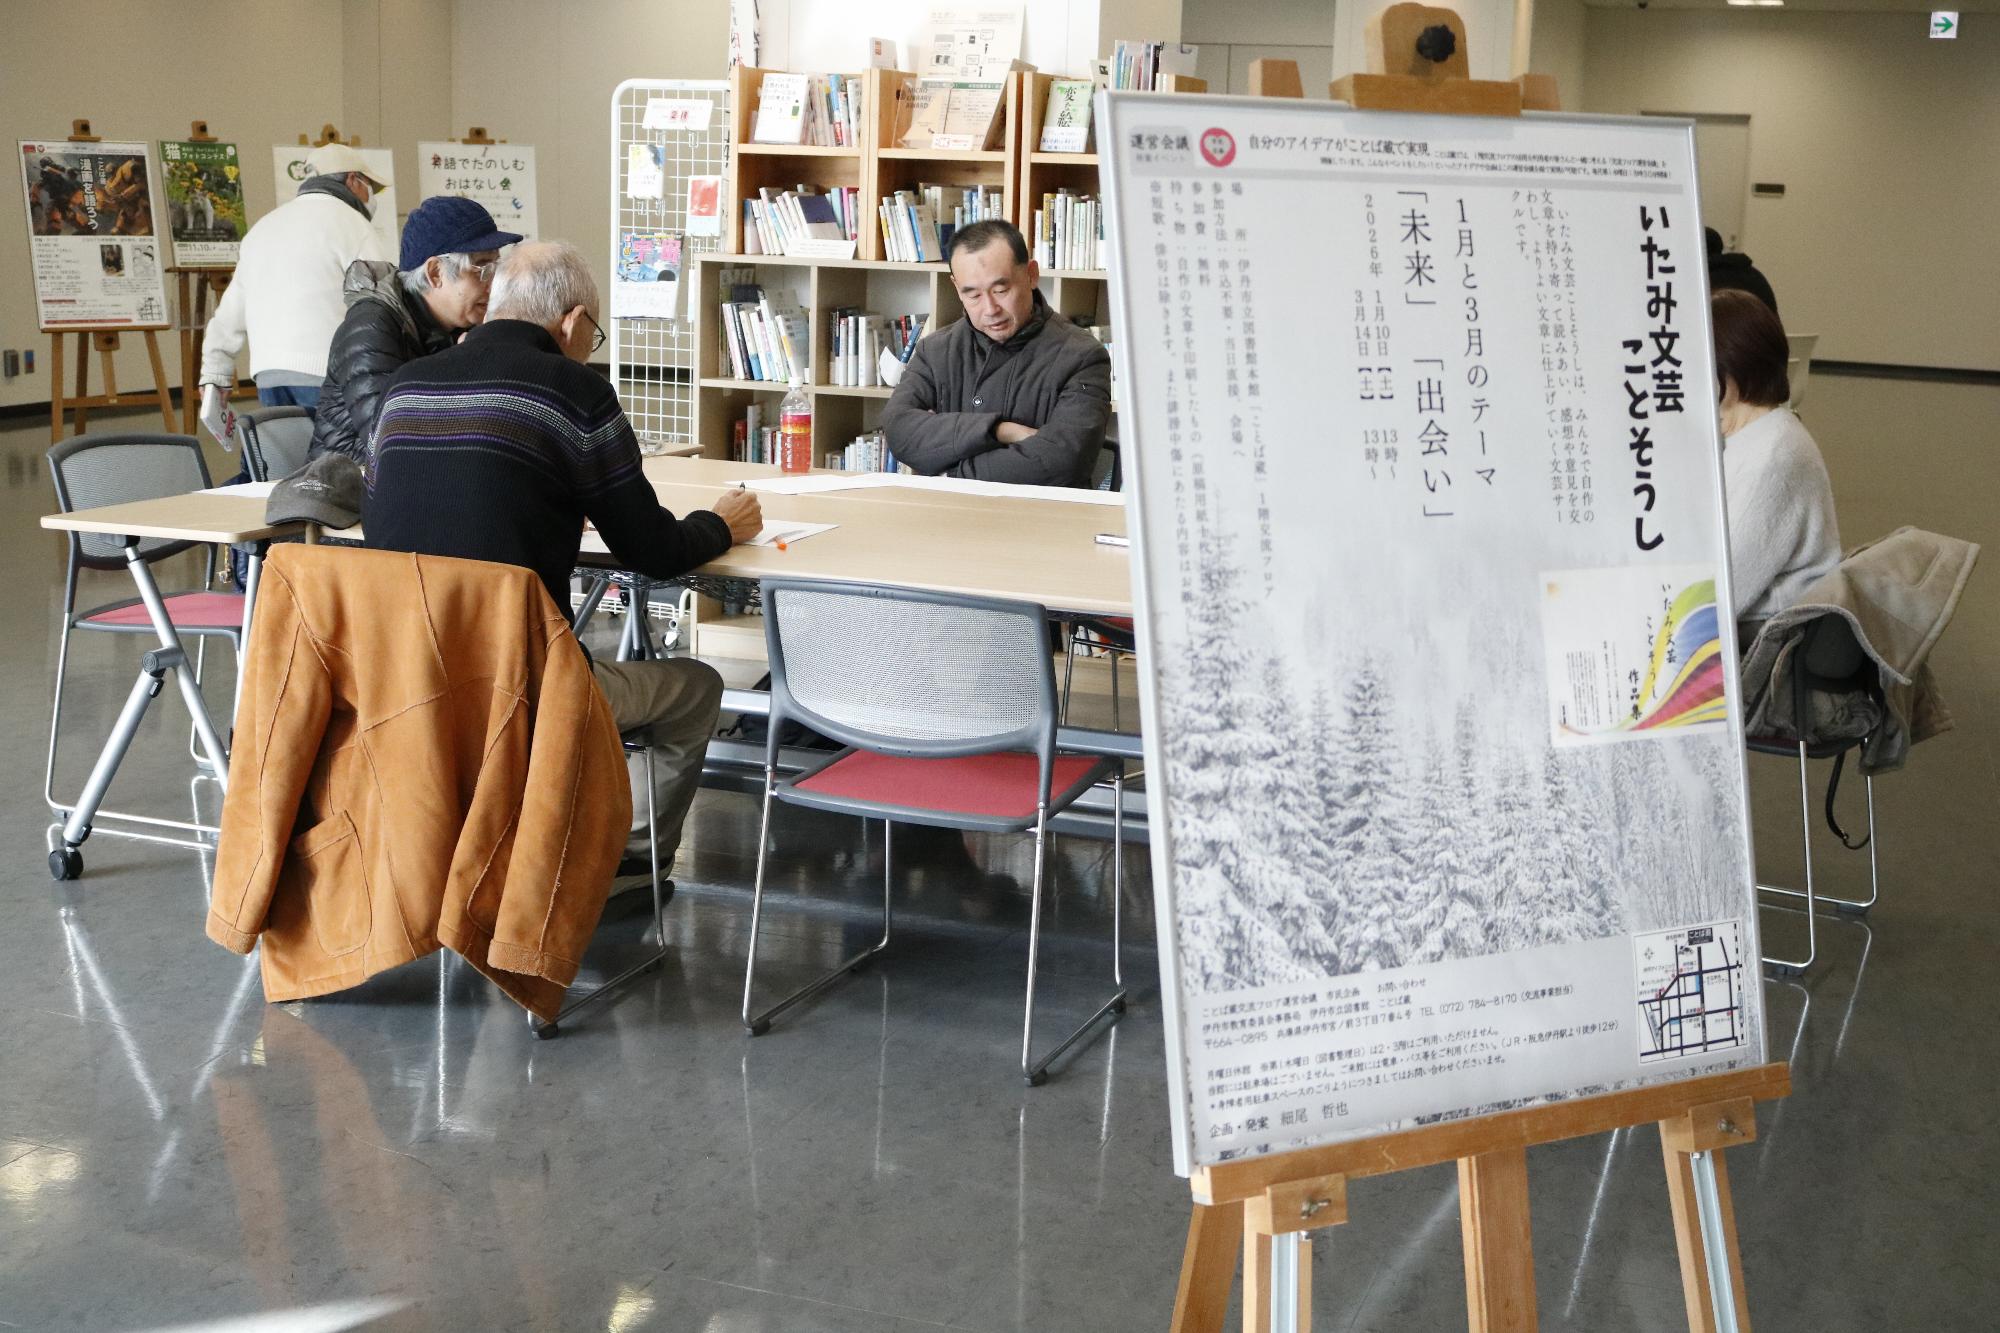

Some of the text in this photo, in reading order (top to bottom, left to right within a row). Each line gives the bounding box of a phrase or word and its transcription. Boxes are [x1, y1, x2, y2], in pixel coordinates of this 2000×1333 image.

[164, 143, 180, 160] 猫
[1130, 134, 1191, 152] 運営会議
[80, 158, 99, 230] 漫画を語ろう
[1364, 194, 1383, 278] 2026年
[1456, 198, 1496, 486] 1月と3月のテーマ
[1640, 206, 1684, 413] いたみ文芸
[1622, 340, 1665, 551] ことそうし
[1628, 669, 1643, 720] 作品集
[1420, 1007, 1435, 1017] TEL
